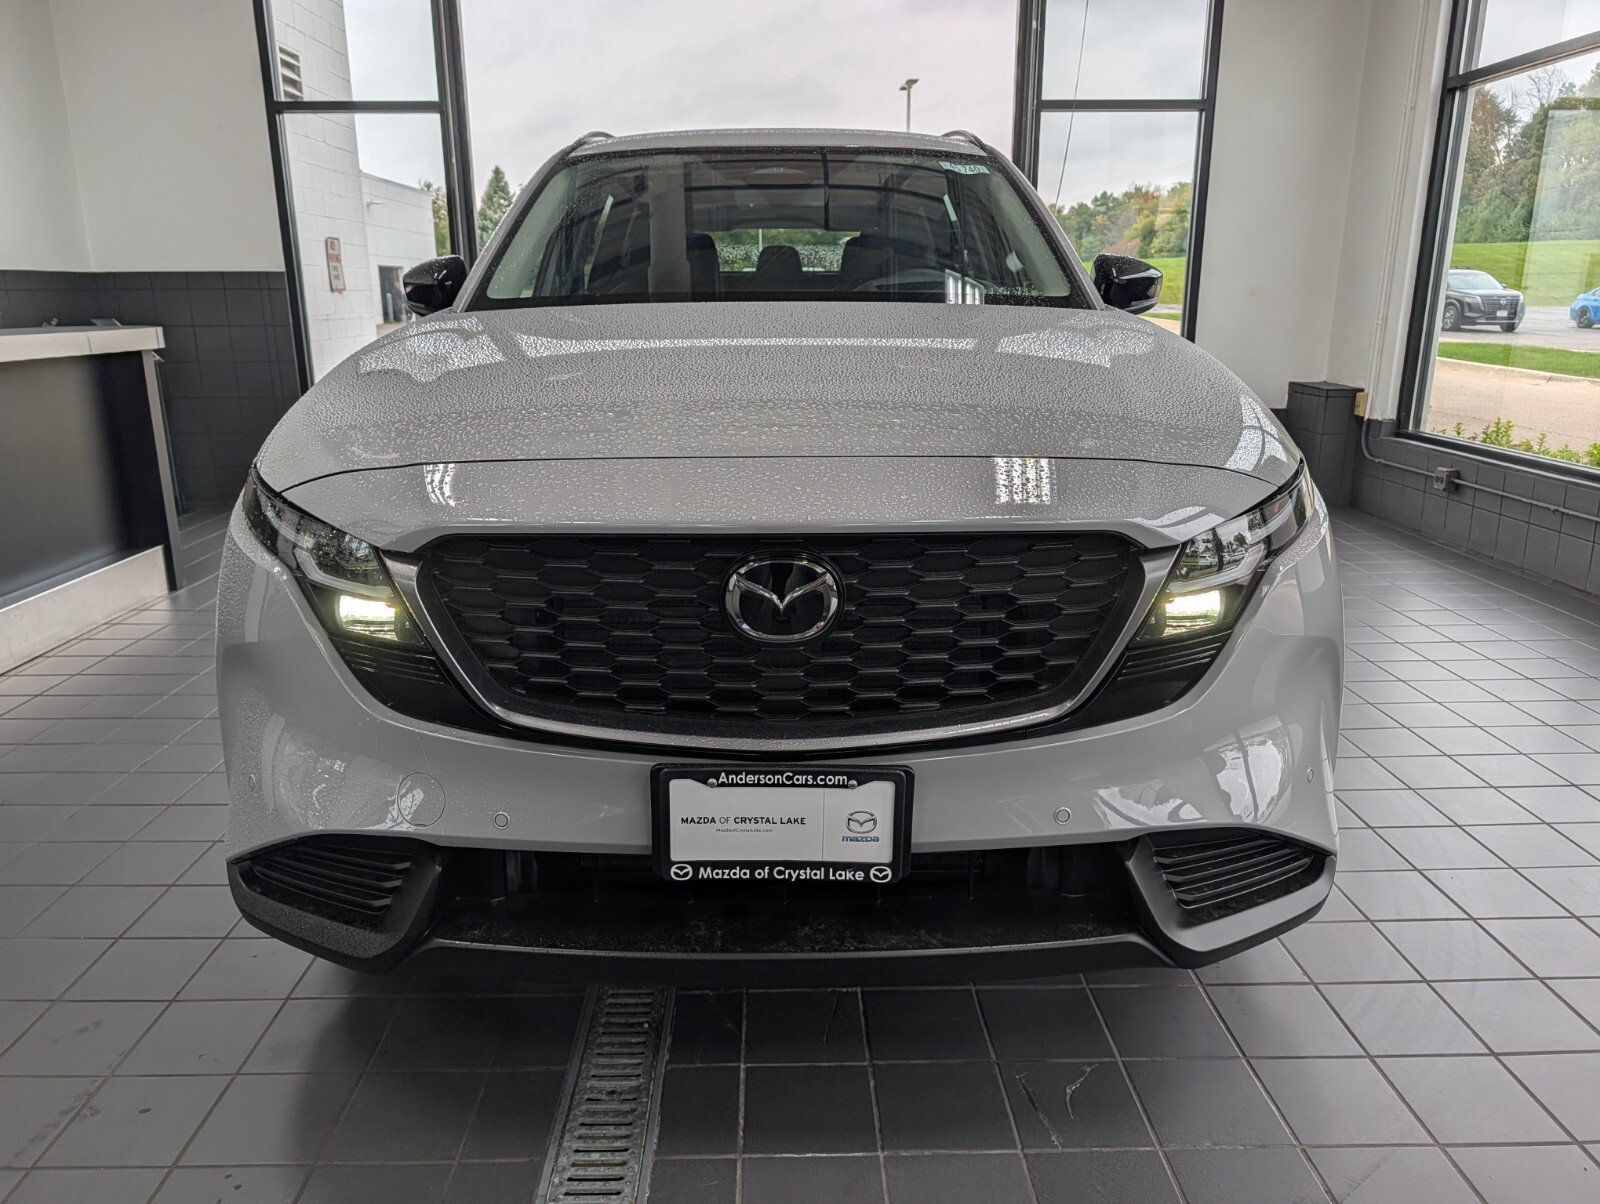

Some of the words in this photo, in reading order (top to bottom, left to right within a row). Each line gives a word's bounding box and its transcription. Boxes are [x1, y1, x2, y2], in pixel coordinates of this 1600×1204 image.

[718, 771, 848, 785] AndersonCars.com
[680, 816, 717, 825] MAZDA
[719, 816, 731, 825] OF
[733, 816, 778, 825] CRYSTAL
[780, 817, 806, 825] LAKE
[698, 866, 750, 879] Mazda
[754, 866, 769, 879] of
[773, 866, 825, 882] Crystal
[829, 867, 865, 881] Lake
